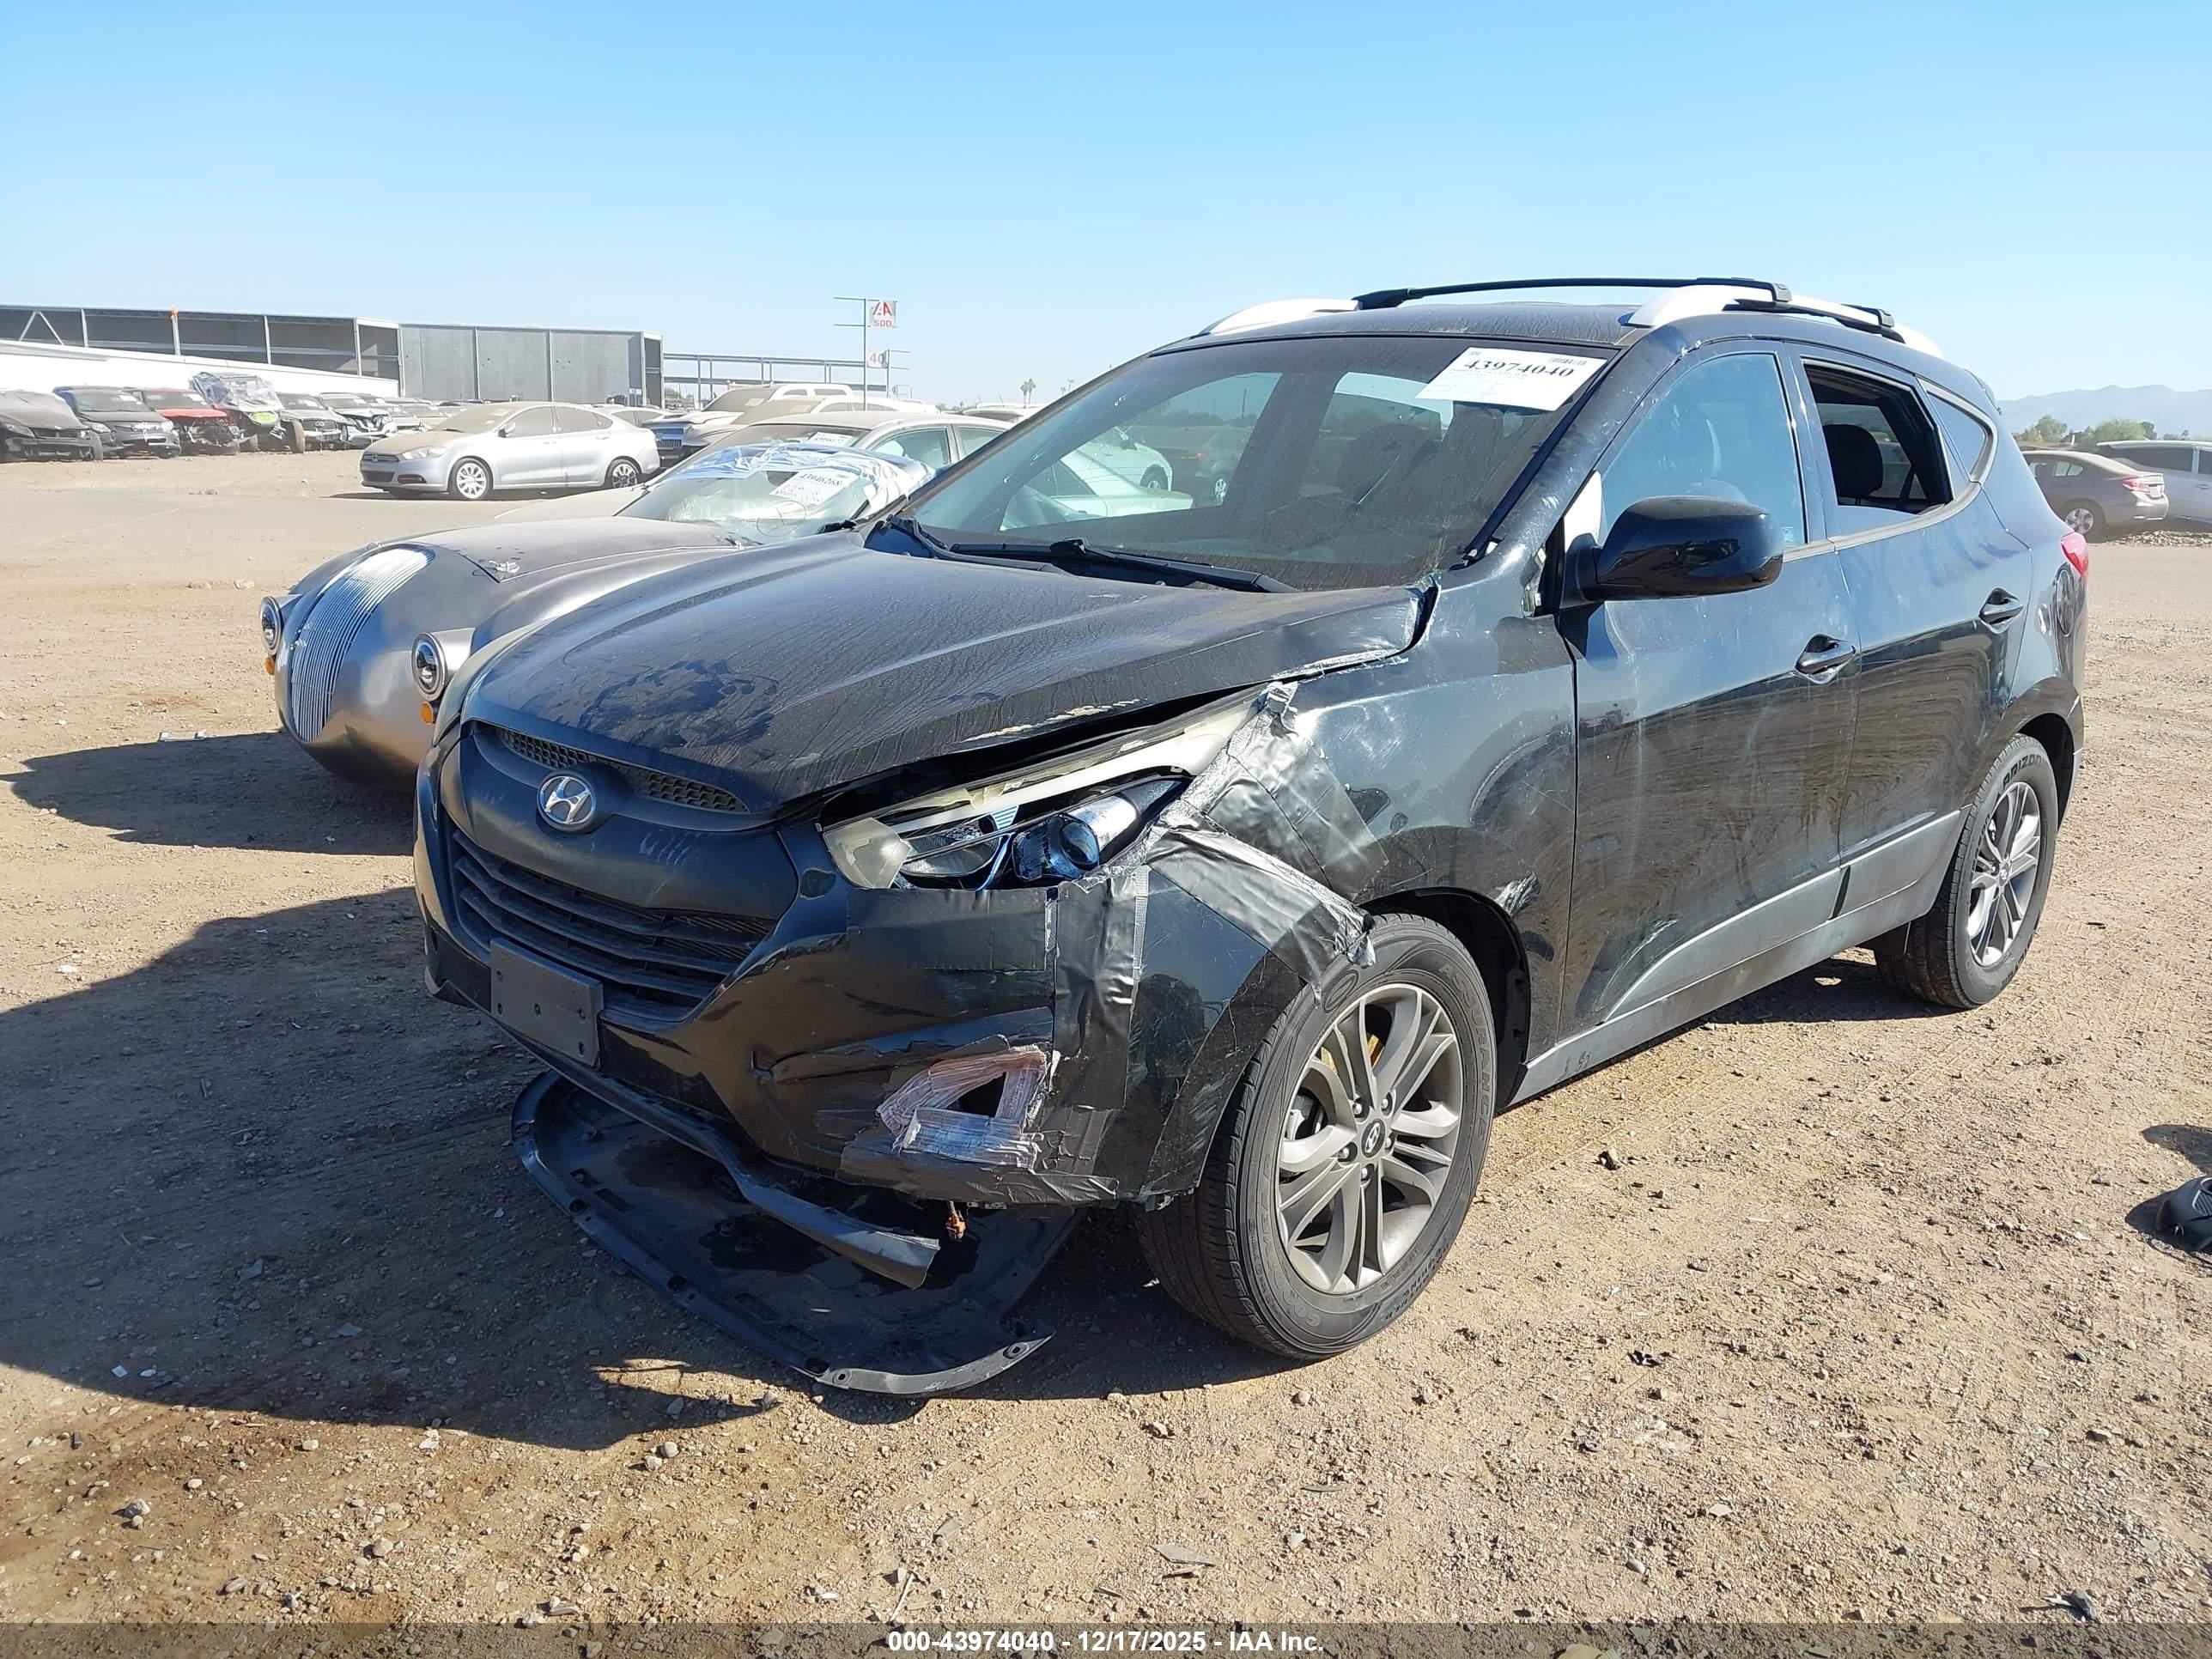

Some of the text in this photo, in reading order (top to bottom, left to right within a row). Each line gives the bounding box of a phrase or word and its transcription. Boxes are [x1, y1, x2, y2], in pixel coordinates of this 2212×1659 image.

[869, 352, 885, 364] 40
[1464, 360, 1574, 377] 43974040
[1438, 963, 1492, 1140] ASSURANCE
